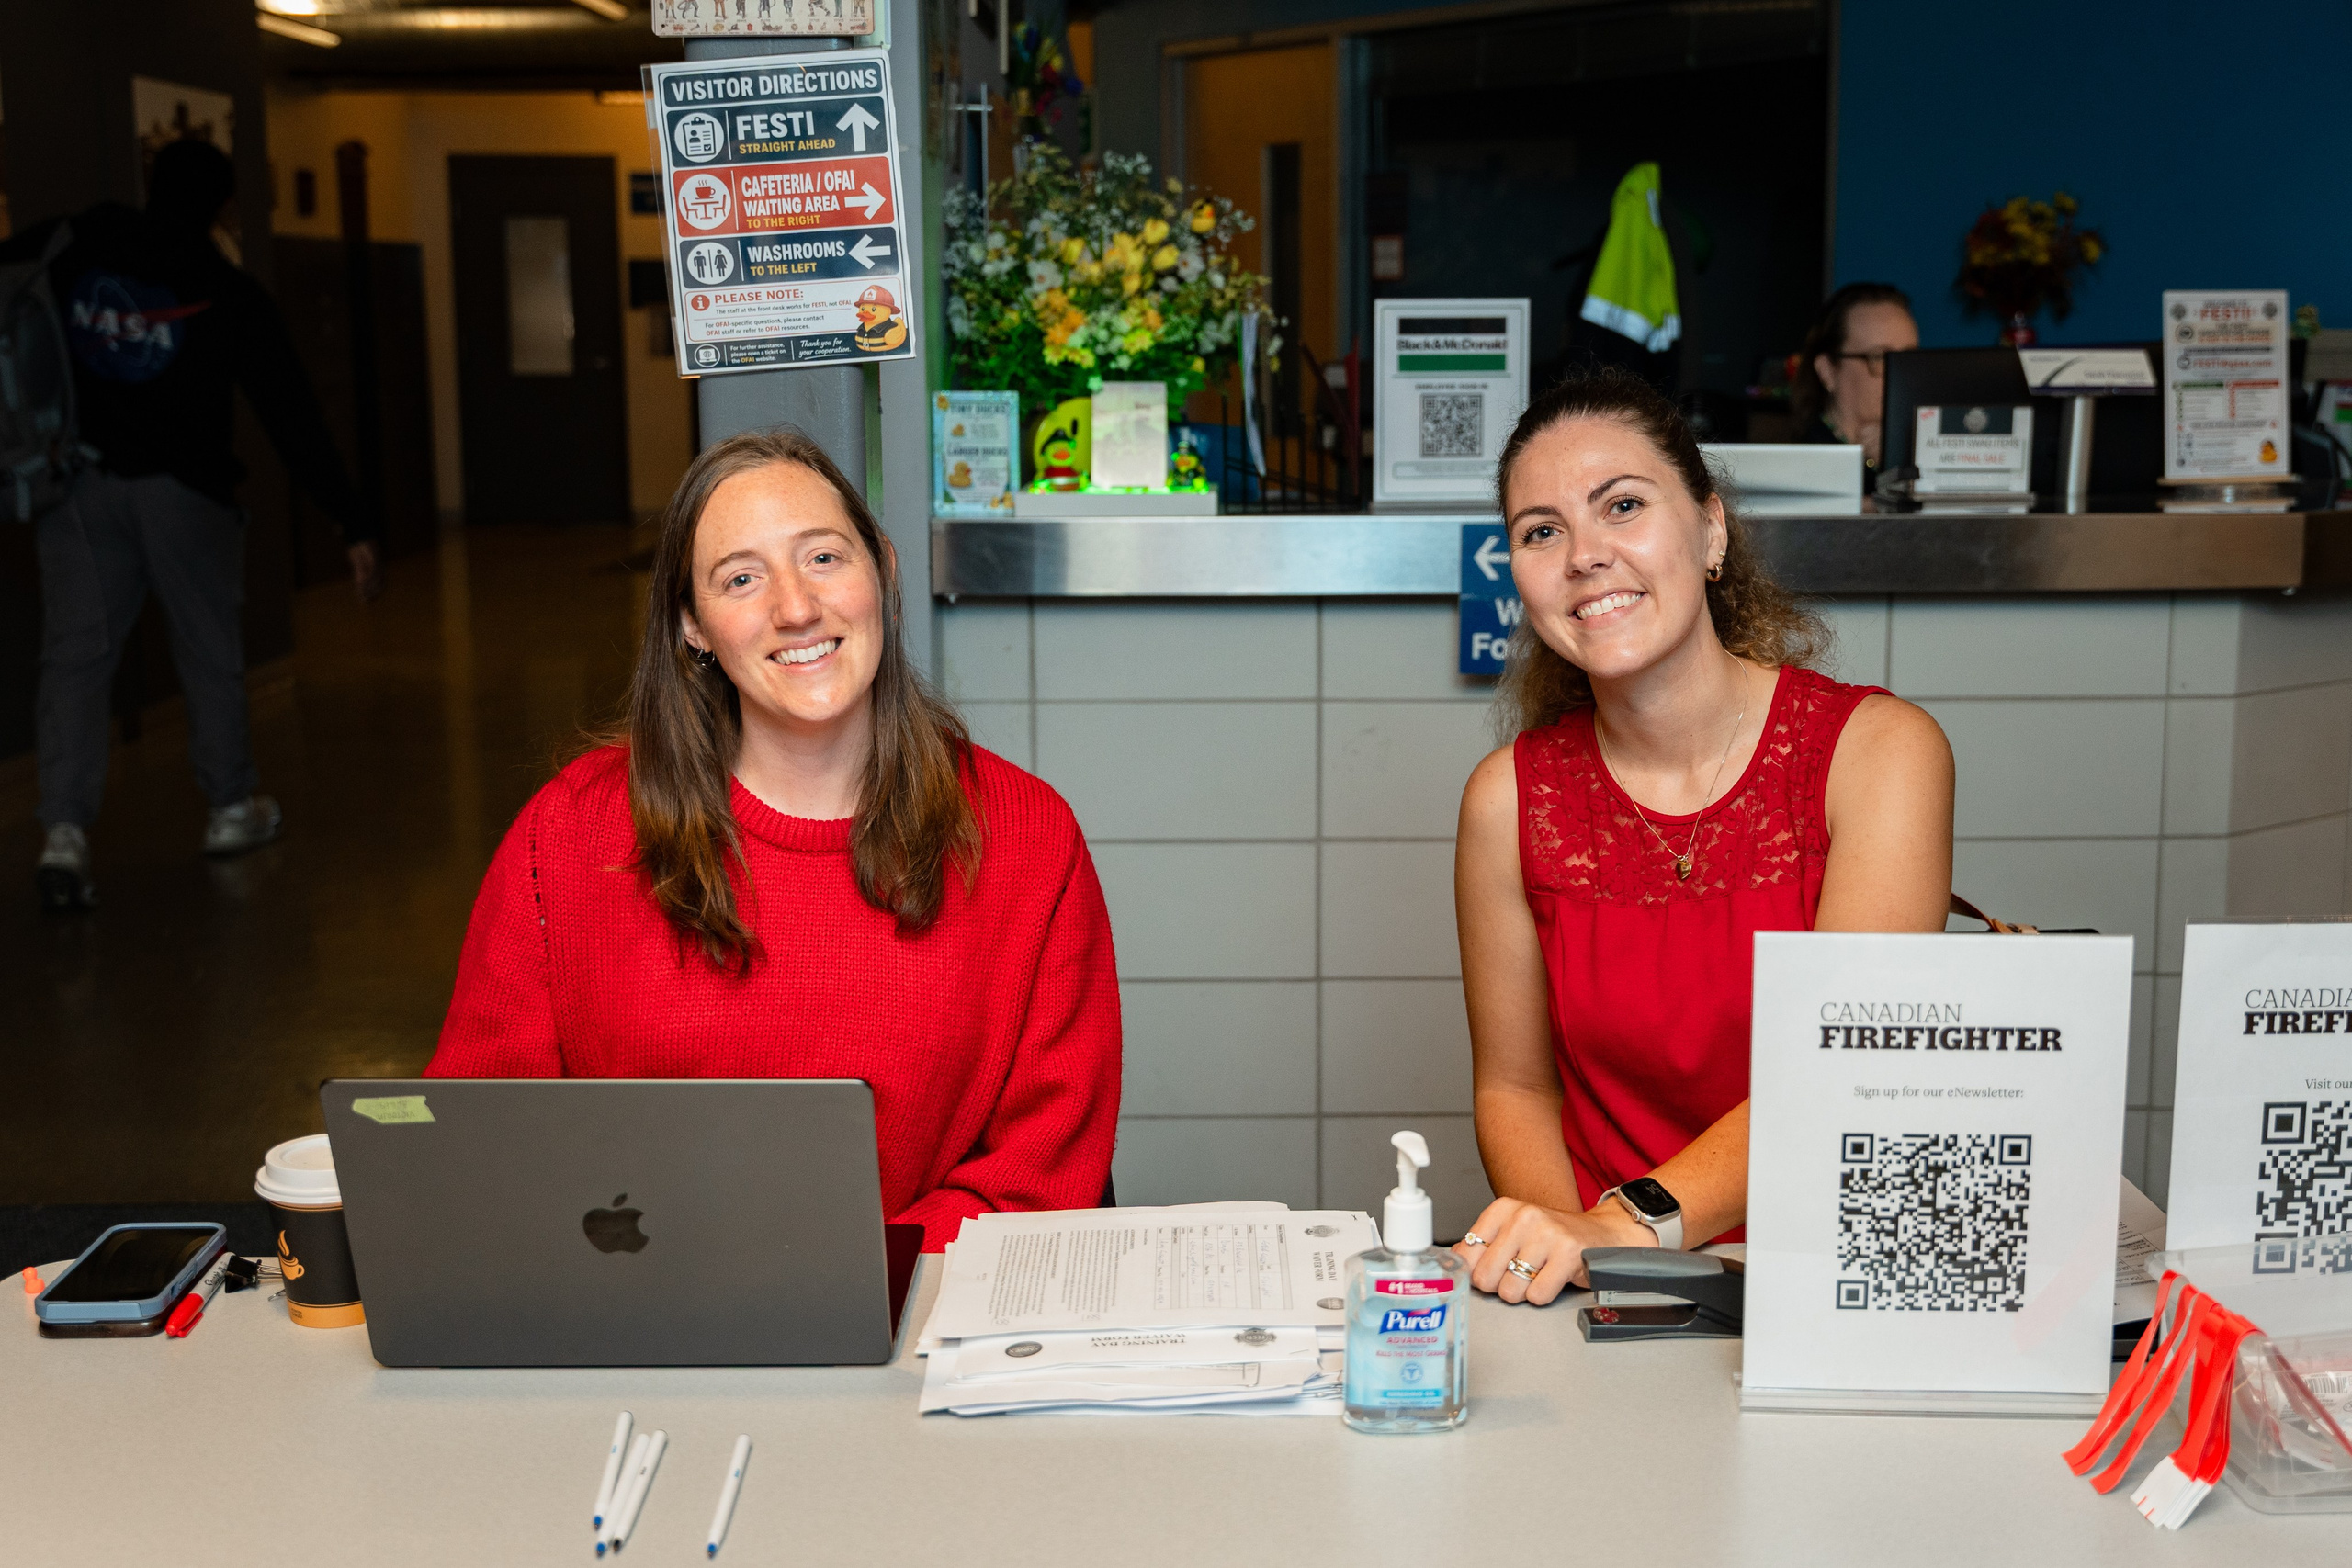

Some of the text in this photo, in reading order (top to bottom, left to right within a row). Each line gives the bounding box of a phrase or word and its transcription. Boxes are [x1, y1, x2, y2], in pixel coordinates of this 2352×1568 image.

[671, 68, 877, 102] VISITOR DIRECTIONS
[736, 111, 815, 140] FESTI
[739, 139, 836, 154] STRAIGHT AHEAD
[741, 169, 855, 197] CAFETERIA / OFAI
[743, 195, 841, 217] WAITING AREA
[746, 215, 820, 229] TO THE RIGHT
[747, 241, 846, 263] WASHROOMS
[750, 262, 817, 276] TO THE LEFT
[715, 288, 804, 304] PLEASE NOTE:
[757, 304, 771, 312] front
[74, 300, 174, 351] NASA
[715, 320, 752, 329] OFAI-specific
[753, 318, 782, 326] questions,
[783, 316, 802, 324] please
[800, 339, 820, 347] Thank
[798, 349, 813, 358] your
[1820, 1002, 1962, 1023] CANADIAN
[1818, 1024, 2063, 1051] FIREFIGHTER
[2305, 1078, 2332, 1089] Visit
[1853, 1085, 2024, 1100] Sign up for our eNewsletter:
[1388, 1281, 1404, 1294] #1
[1386, 1309, 1442, 1330] Purell
[1386, 1336, 1439, 1344] ADVANCED
